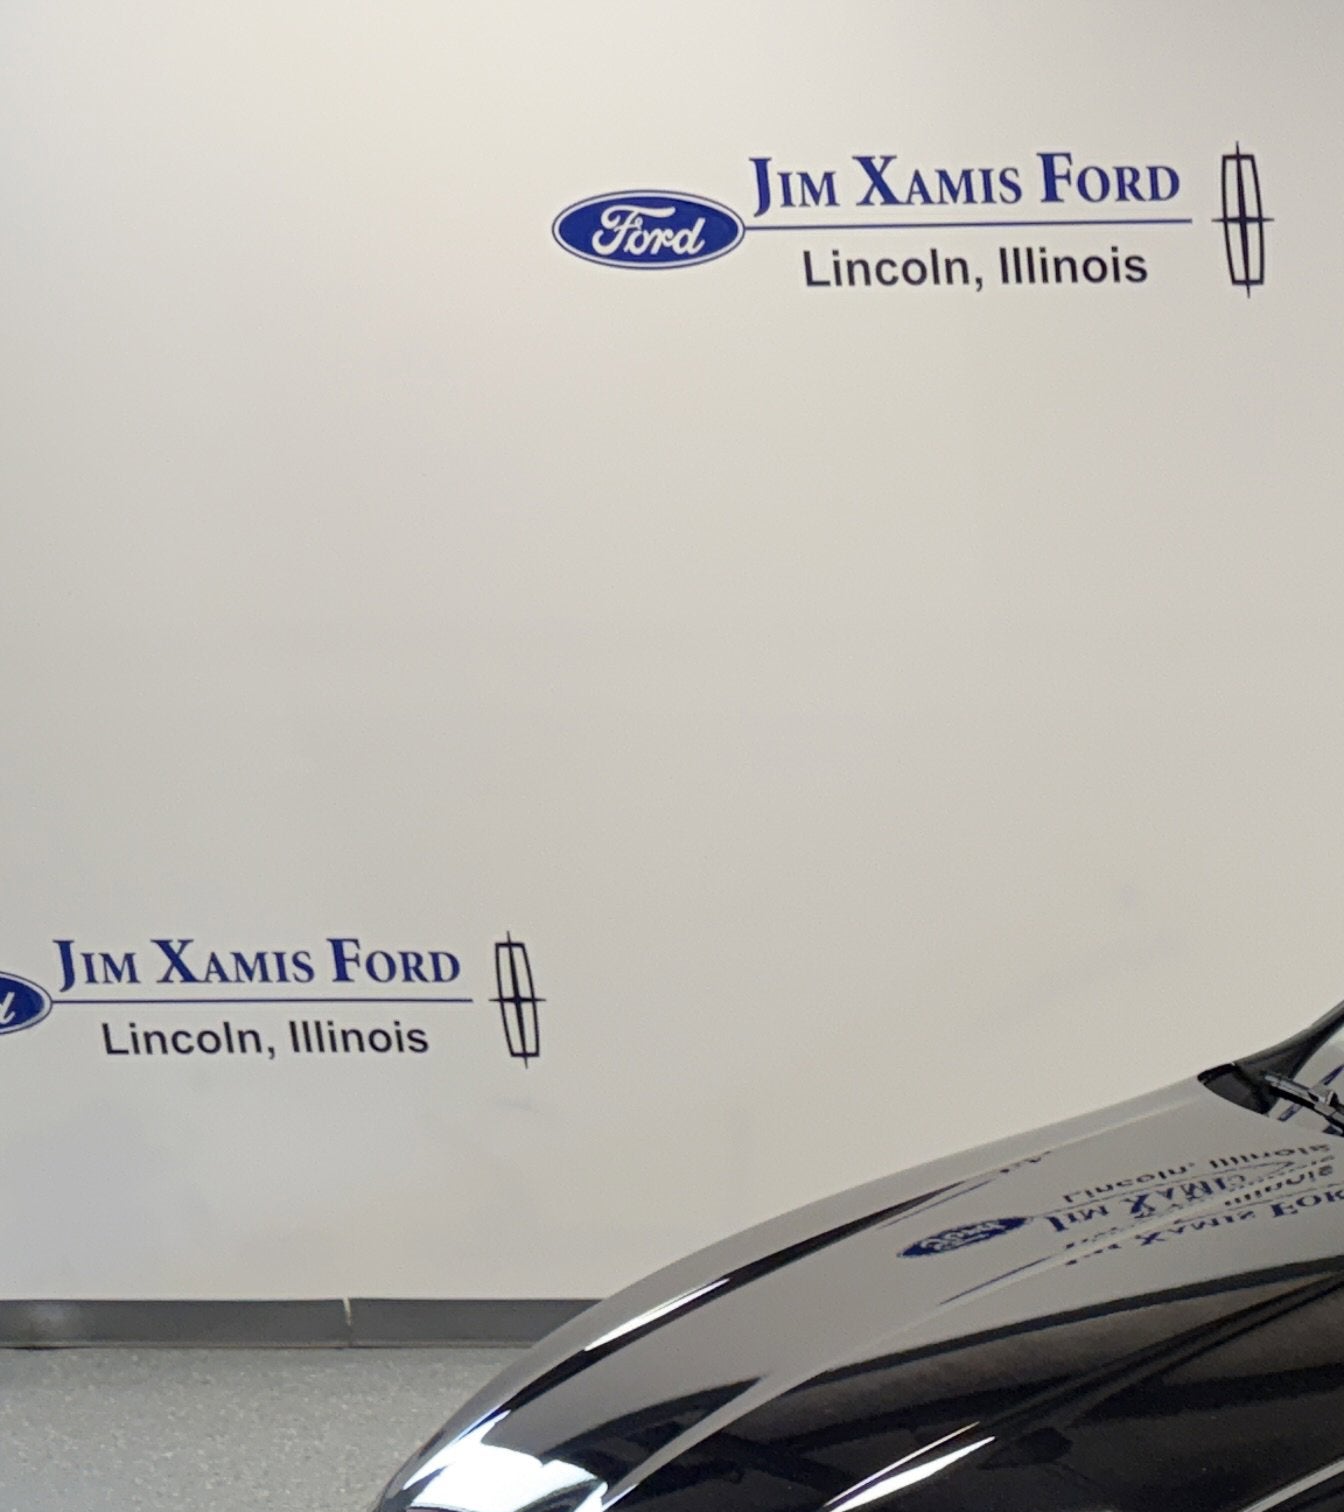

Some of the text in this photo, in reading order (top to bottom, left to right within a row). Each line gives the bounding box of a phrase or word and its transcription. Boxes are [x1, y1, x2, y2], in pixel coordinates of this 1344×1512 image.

[748, 150, 1180, 218] JIM XAMIS FORD
[592, 203, 706, 256] Ford
[802, 246, 1149, 293] Lincoln, Illinois
[52, 937, 461, 993] JIM XAMIS FORD
[101, 1019, 430, 1060] Lincoln, Illinois
